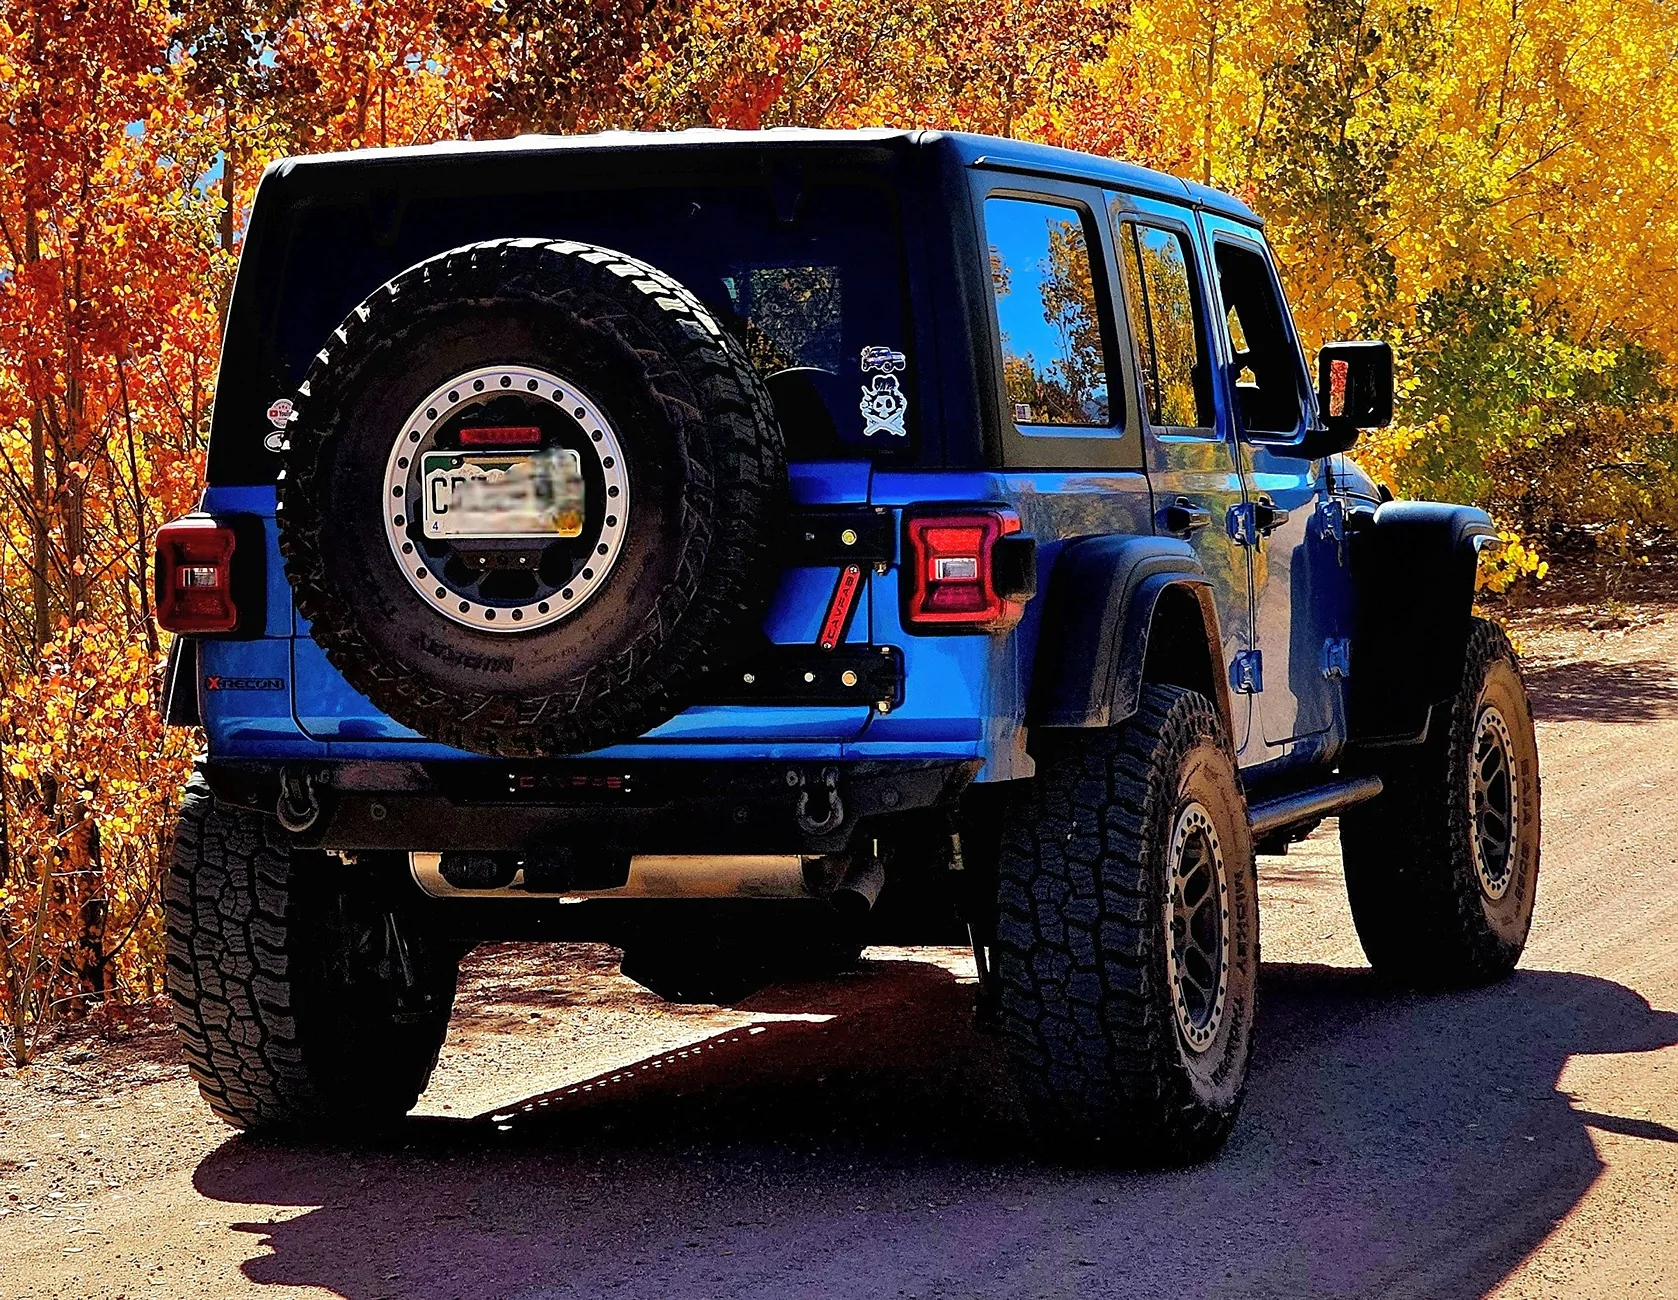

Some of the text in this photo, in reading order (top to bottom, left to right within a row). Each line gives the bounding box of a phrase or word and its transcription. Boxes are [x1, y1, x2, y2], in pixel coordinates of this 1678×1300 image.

[432, 521, 439, 531] 4
[827, 576, 854, 640] CAVFAB
[1521, 758, 1532, 826] BAJA
